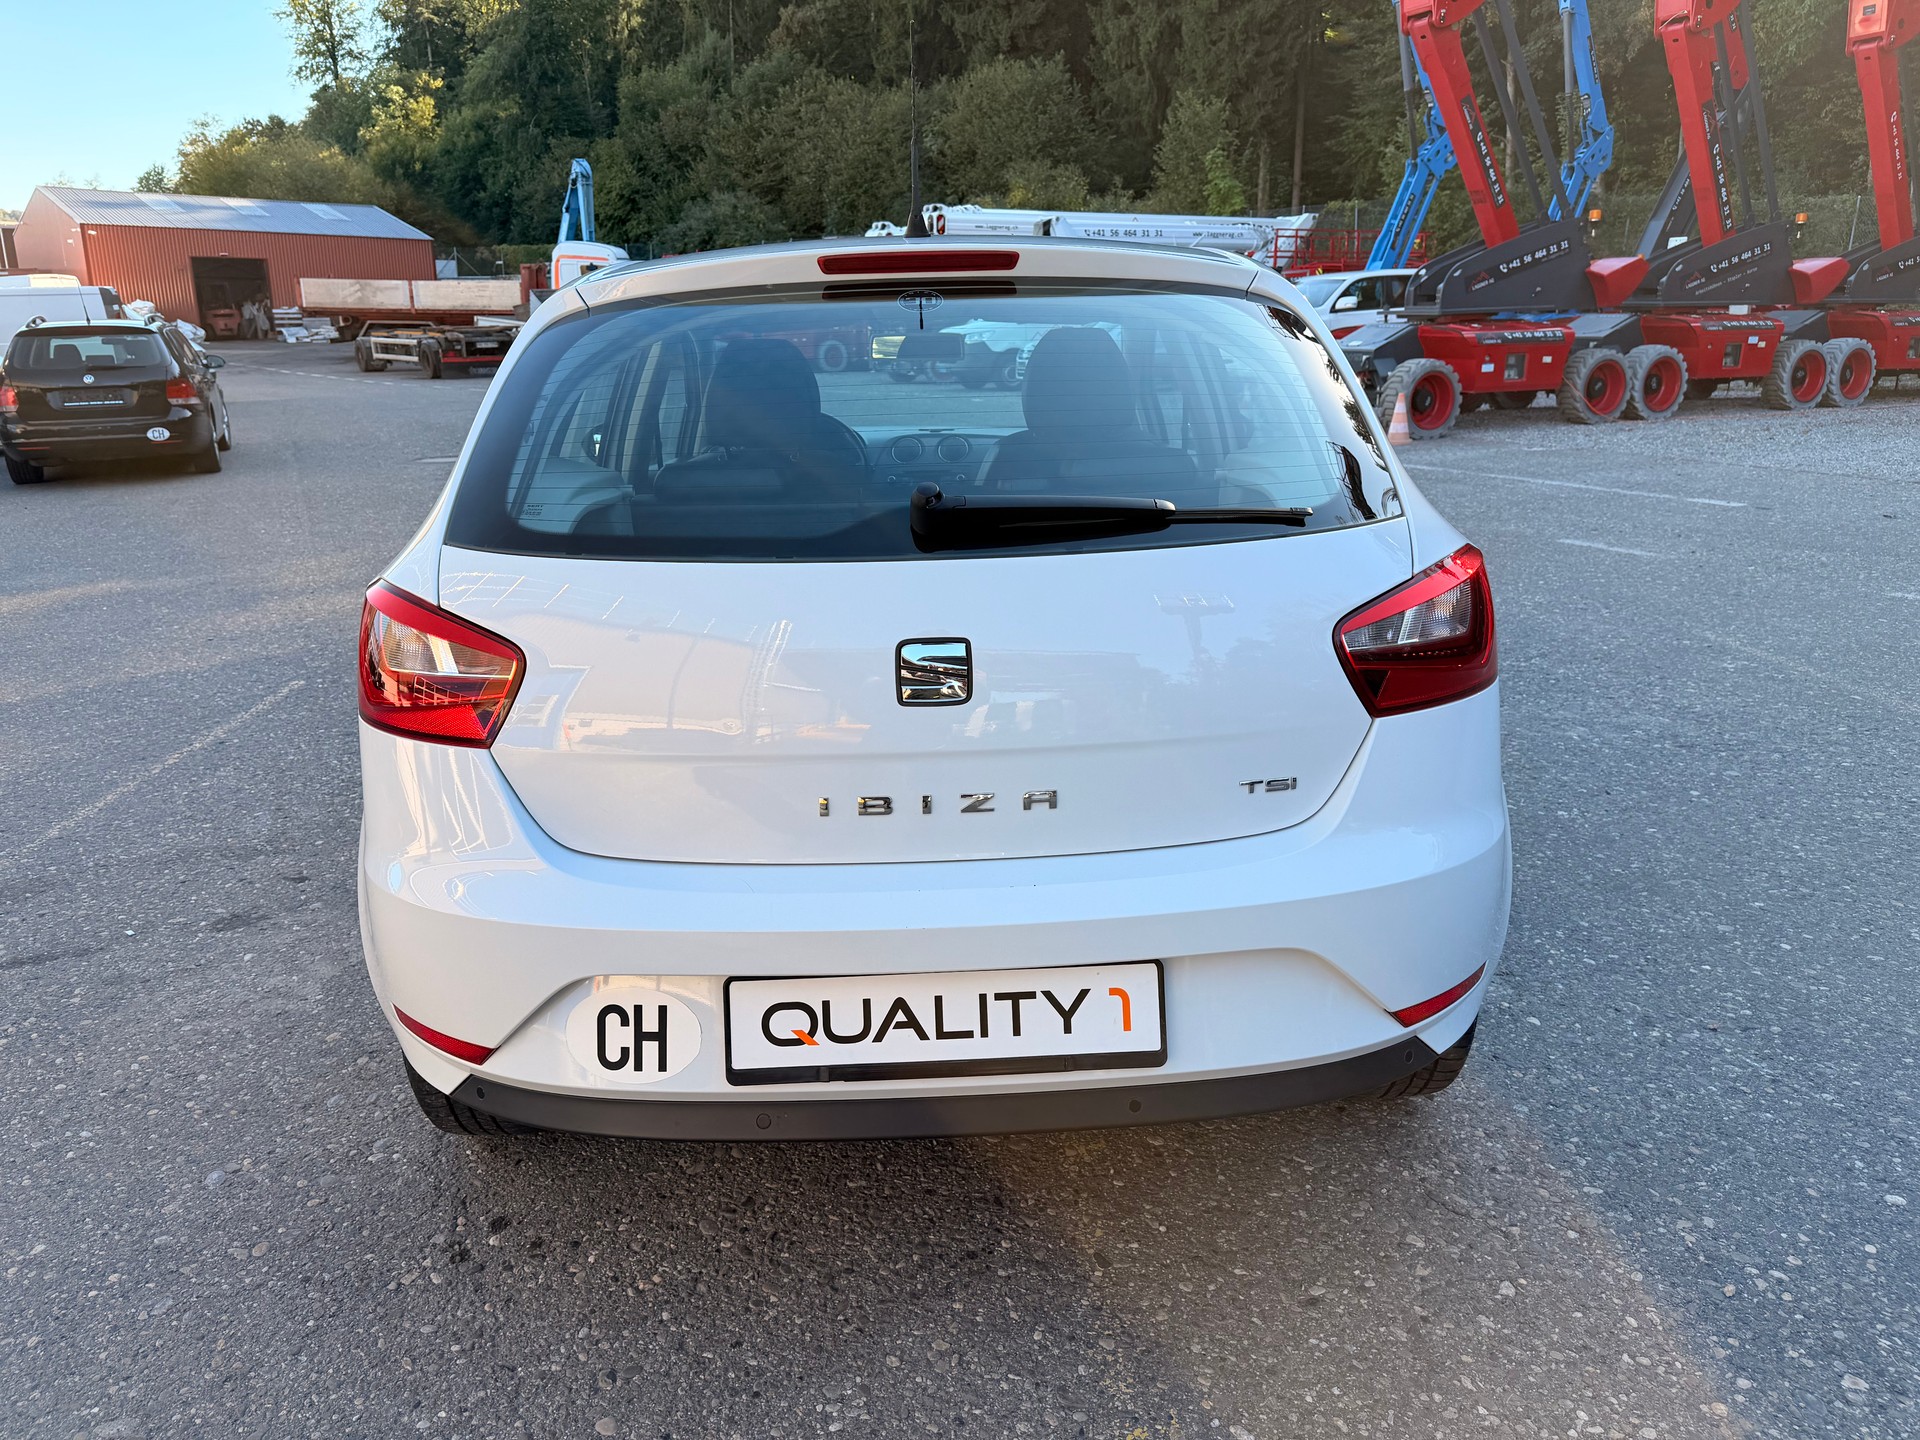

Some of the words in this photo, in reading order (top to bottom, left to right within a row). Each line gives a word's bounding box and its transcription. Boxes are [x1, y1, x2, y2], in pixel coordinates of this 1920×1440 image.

[1480, 142, 1488, 155] +41
[1485, 156, 1491, 166] 56
[1494, 183, 1500, 193] 31
[1497, 194, 1504, 204] 31
[1718, 173, 1724, 184] 56
[1724, 205, 1730, 215] 31
[1092, 229, 1105, 237] +41
[1110, 229, 1119, 237] 56
[1123, 229, 1137, 237] 464
[1726, 218, 1732, 229] 31
[1509, 258, 1521, 269] +41
[1523, 254, 1532, 264] 56
[1534, 249, 1547, 258] 464
[1549, 245, 1558, 254] 31
[1560, 241, 1569, 249] 31
[1718, 260, 1728, 269] +41
[1731, 256, 1738, 264] 56
[1741, 251, 1751, 260] 464
[1754, 247, 1761, 255] 31
[1764, 243, 1771, 251] 31
[152, 430, 165, 439] CH
[819, 790, 1057, 816] IBIZA
[761, 988, 1092, 1047] QUALITY
[1108, 987, 1132, 1032] 1
[596, 1004, 668, 1072] CH
